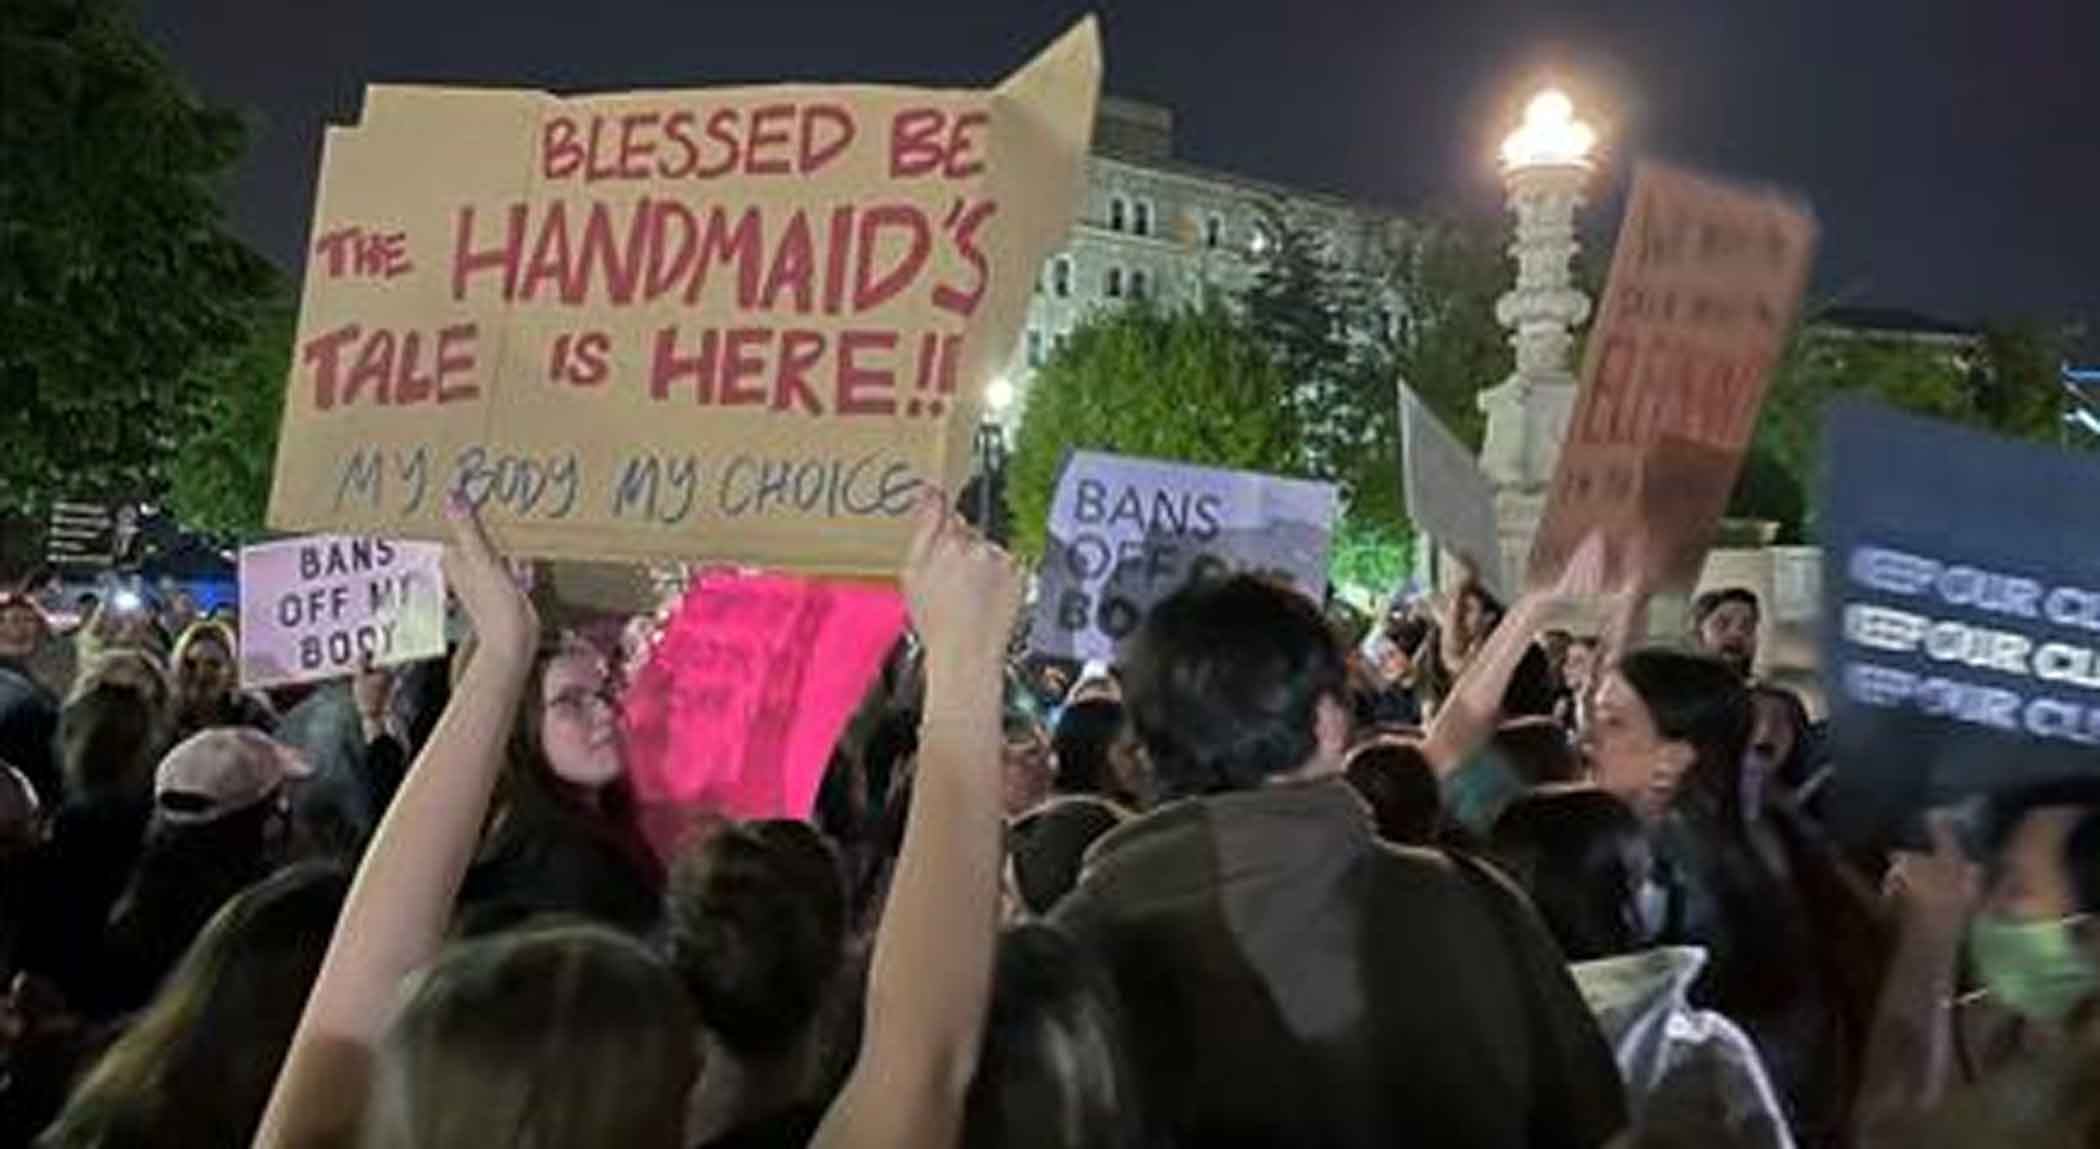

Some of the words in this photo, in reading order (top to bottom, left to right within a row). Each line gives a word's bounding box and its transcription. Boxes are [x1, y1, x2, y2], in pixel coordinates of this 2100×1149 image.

[544, 105, 856, 180] BLESSED
[888, 109, 991, 179] BE
[317, 226, 414, 282] THE
[452, 199, 998, 316] HANDMAID'S
[304, 323, 480, 411] TALE
[550, 333, 611, 388] IS
[649, 327, 963, 419] HERE!!
[335, 449, 434, 514] MY
[452, 445, 579, 519] BODY
[613, 455, 699, 523] MY
[716, 447, 925, 517] CHOICE
[1074, 478, 1222, 542] BANS
[300, 537, 396, 580] BANS
[1066, 532, 1180, 602] OFF
[279, 586, 349, 628] OFF
[299, 620, 397, 670] BODY
